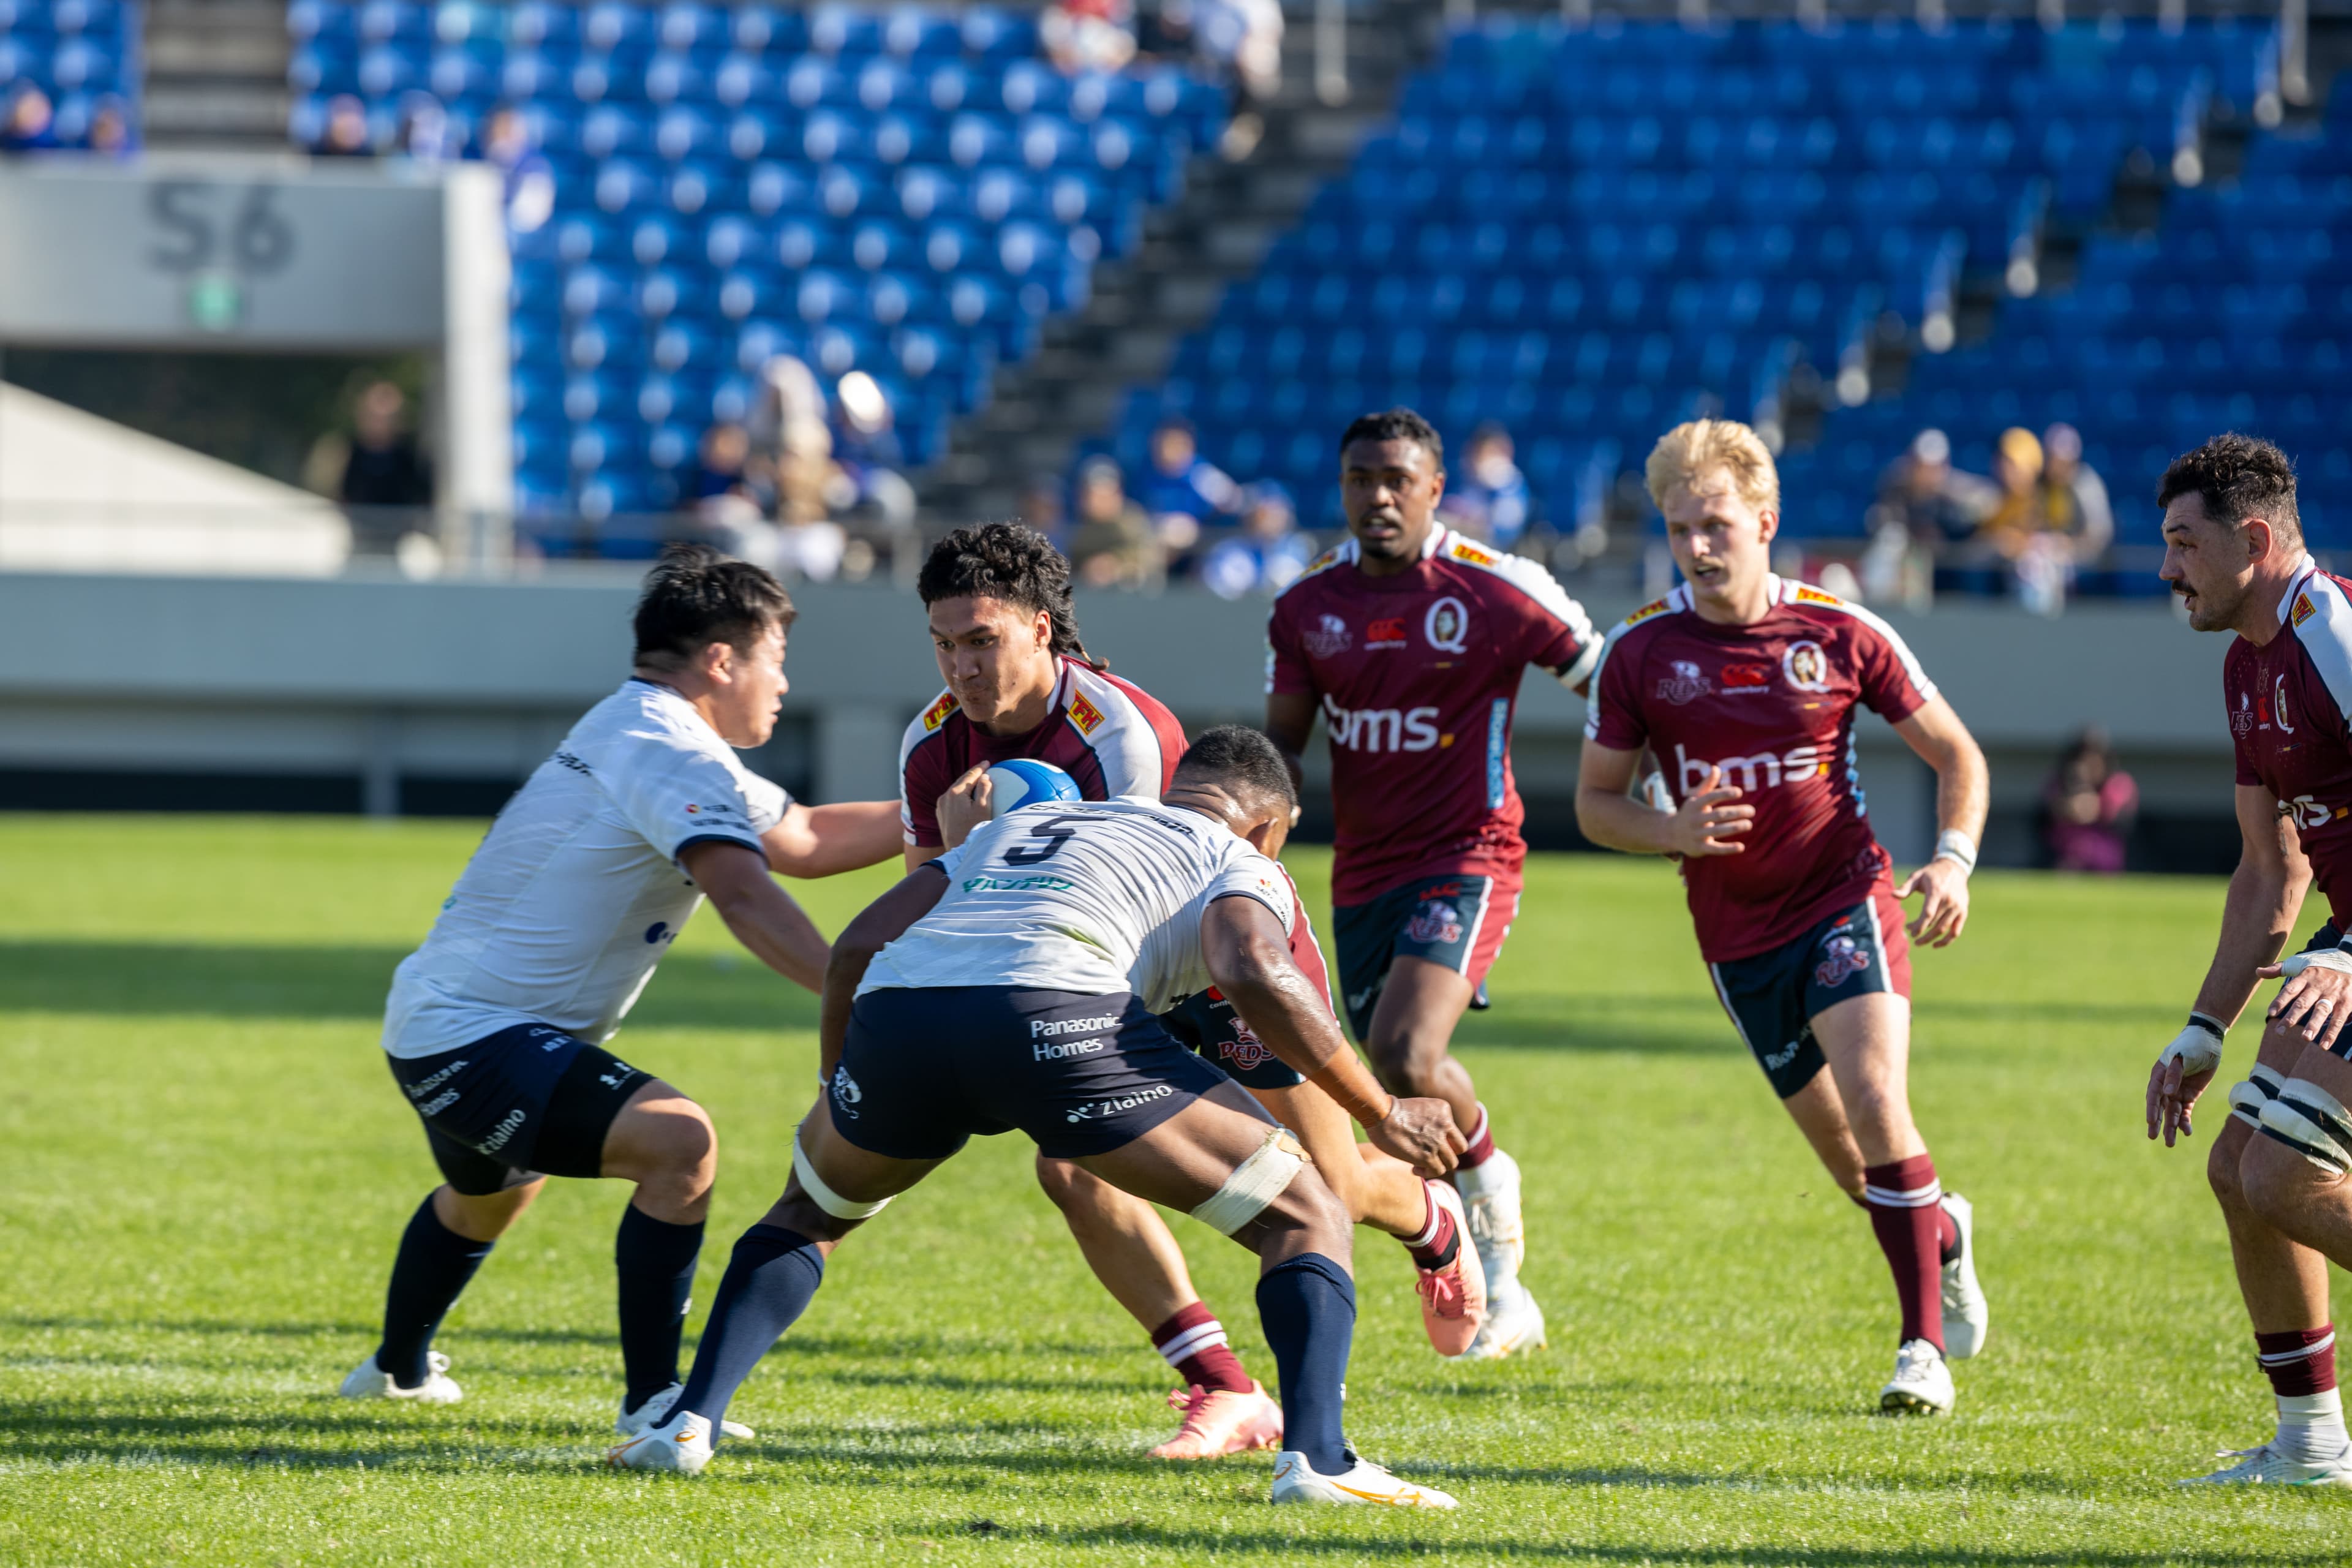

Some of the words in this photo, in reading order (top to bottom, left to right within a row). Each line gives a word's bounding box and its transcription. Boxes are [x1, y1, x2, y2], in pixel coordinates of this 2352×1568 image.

[1424, 597, 1469, 654] Q
[1784, 639, 1831, 693] Q
[1003, 815, 1107, 866] 5
[1031, 1012, 1123, 1038] Panasonic
[1033, 1038, 1104, 1061] Homes
